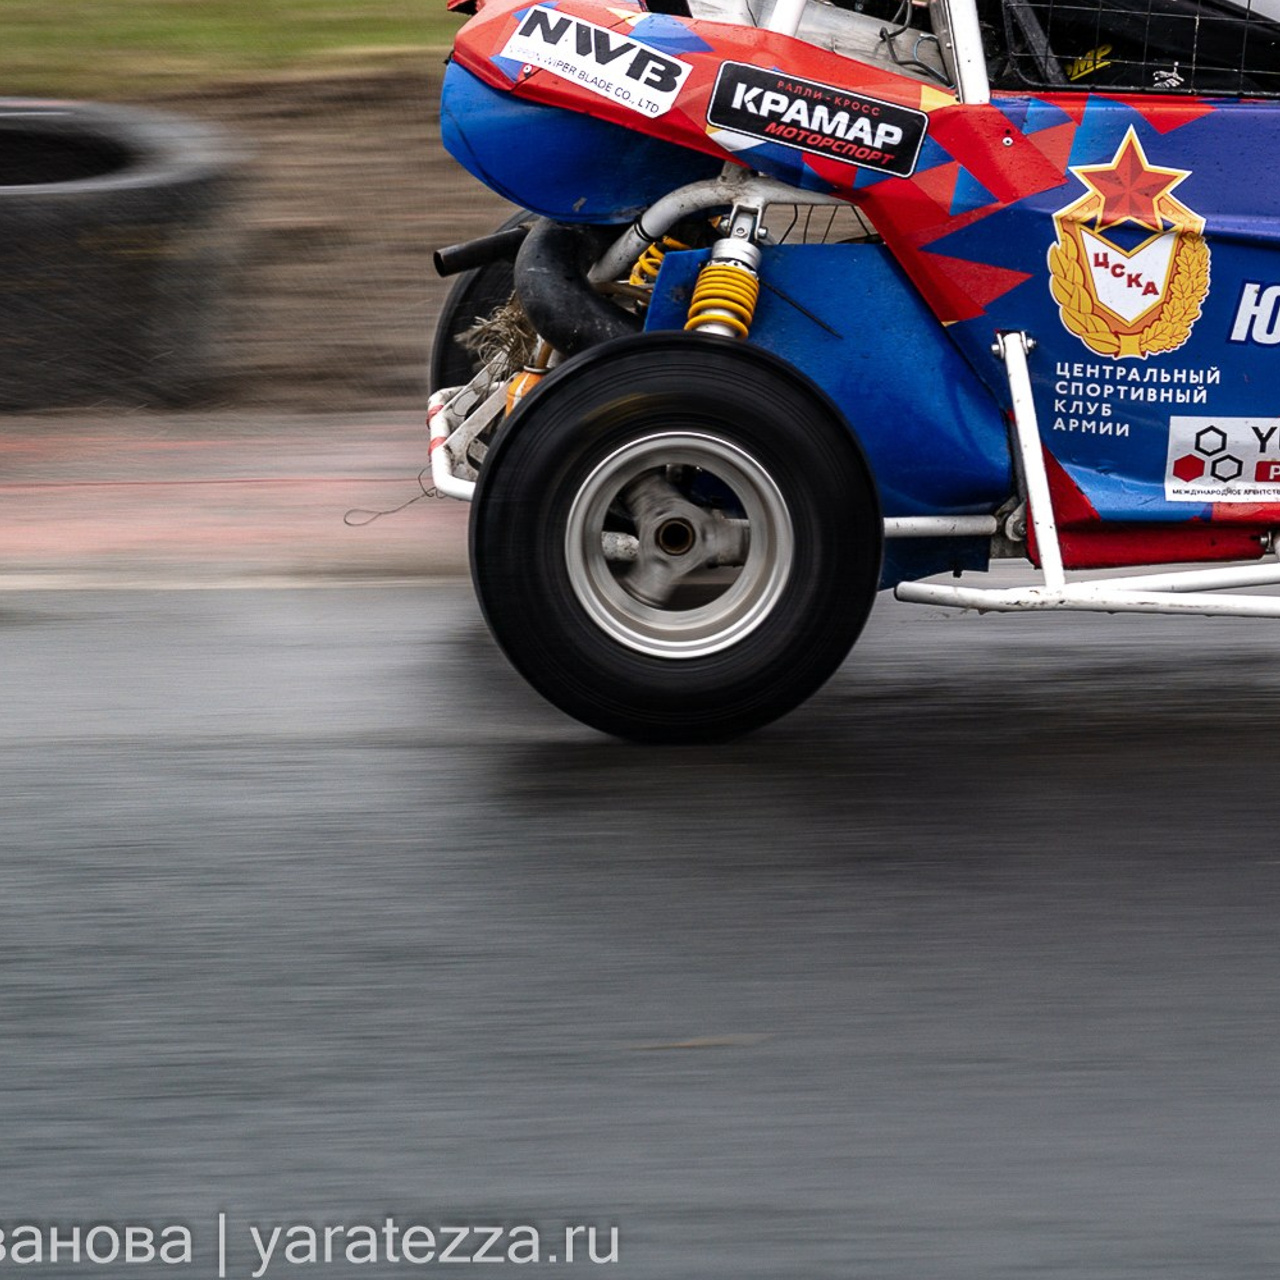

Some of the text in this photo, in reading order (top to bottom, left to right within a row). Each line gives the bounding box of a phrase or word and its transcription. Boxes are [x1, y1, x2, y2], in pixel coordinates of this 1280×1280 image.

[518, 9, 683, 93] NWB
[577, 70, 613, 92] BLADE
[637, 99, 660, 114] LTD
[731, 82, 903, 149] КРАМАР
[764, 121, 896, 165] МОТОРСПОРТ
[1093, 253, 1160, 296] ЦСКА
[1055, 362, 1220, 384] ЦЕНТРАЛЬНЫЙ
[1055, 381, 1208, 404] СПОРТИВНЫЙ
[1053, 419, 1130, 437] АРМИИ
[1054, 400, 1113, 417] КЛУБ
